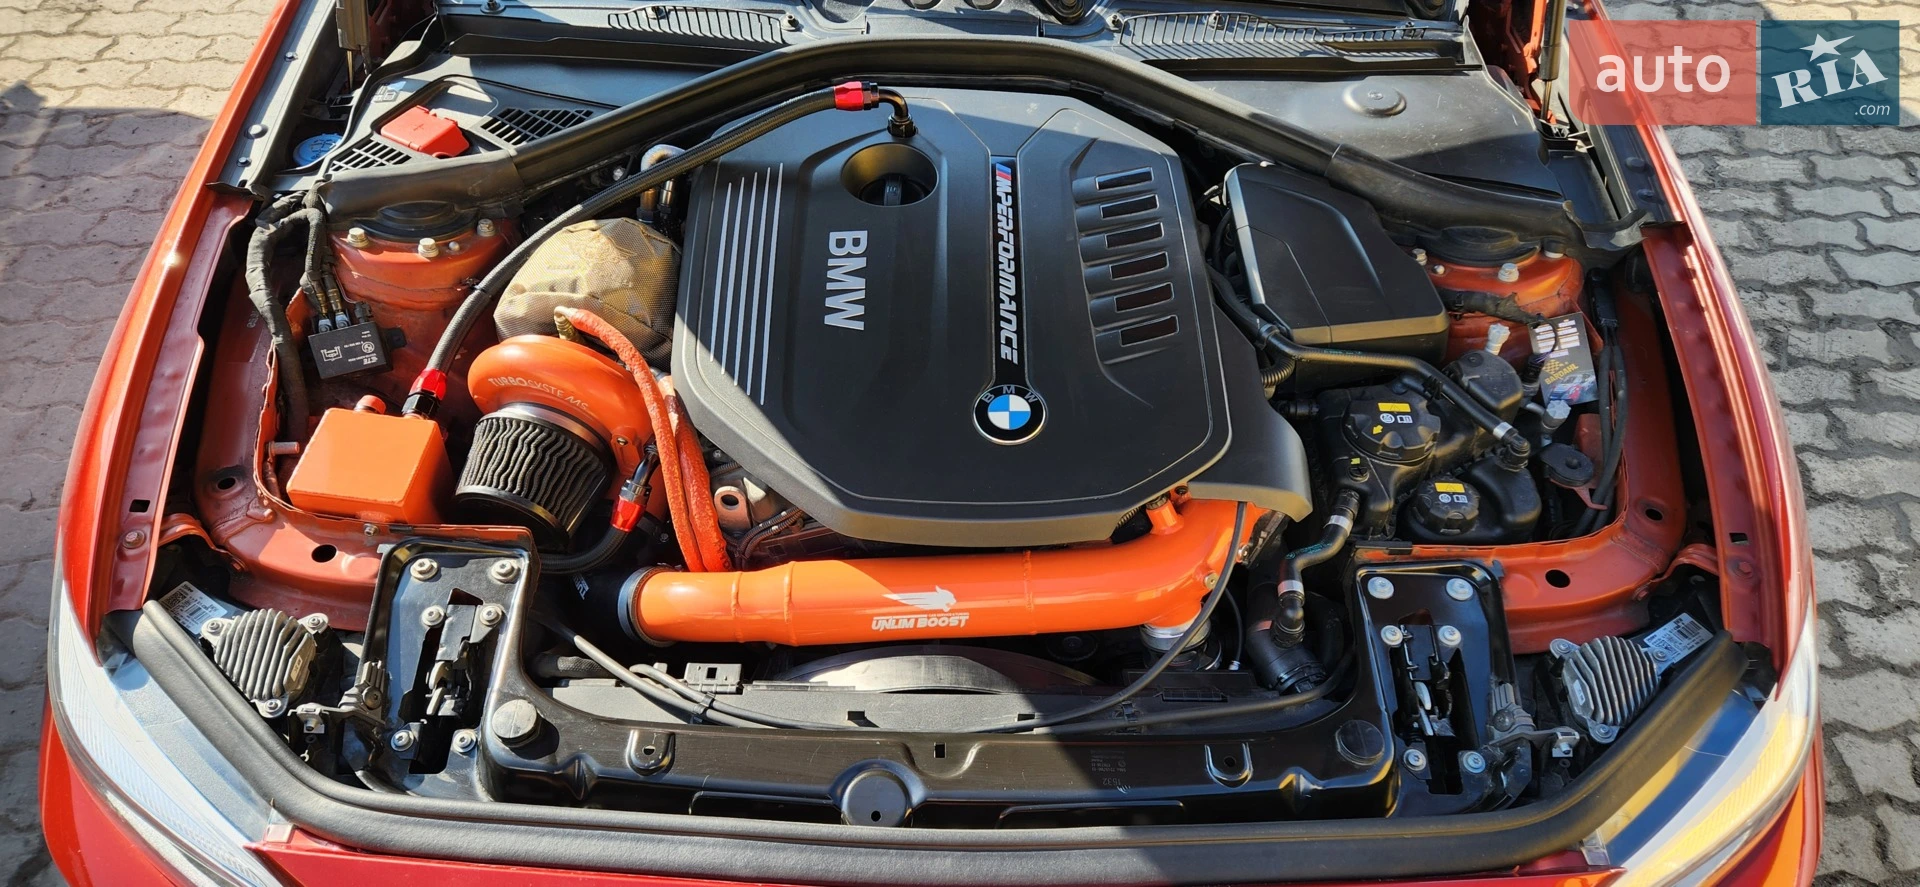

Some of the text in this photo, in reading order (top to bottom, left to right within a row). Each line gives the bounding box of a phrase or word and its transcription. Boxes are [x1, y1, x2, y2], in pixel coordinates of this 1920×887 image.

[824, 230, 868, 331] BMW
[1544, 363, 1579, 385] BARDAHL
[981, 385, 1039, 403] BMW
[871, 614, 970, 632] UNLIM BOOST
